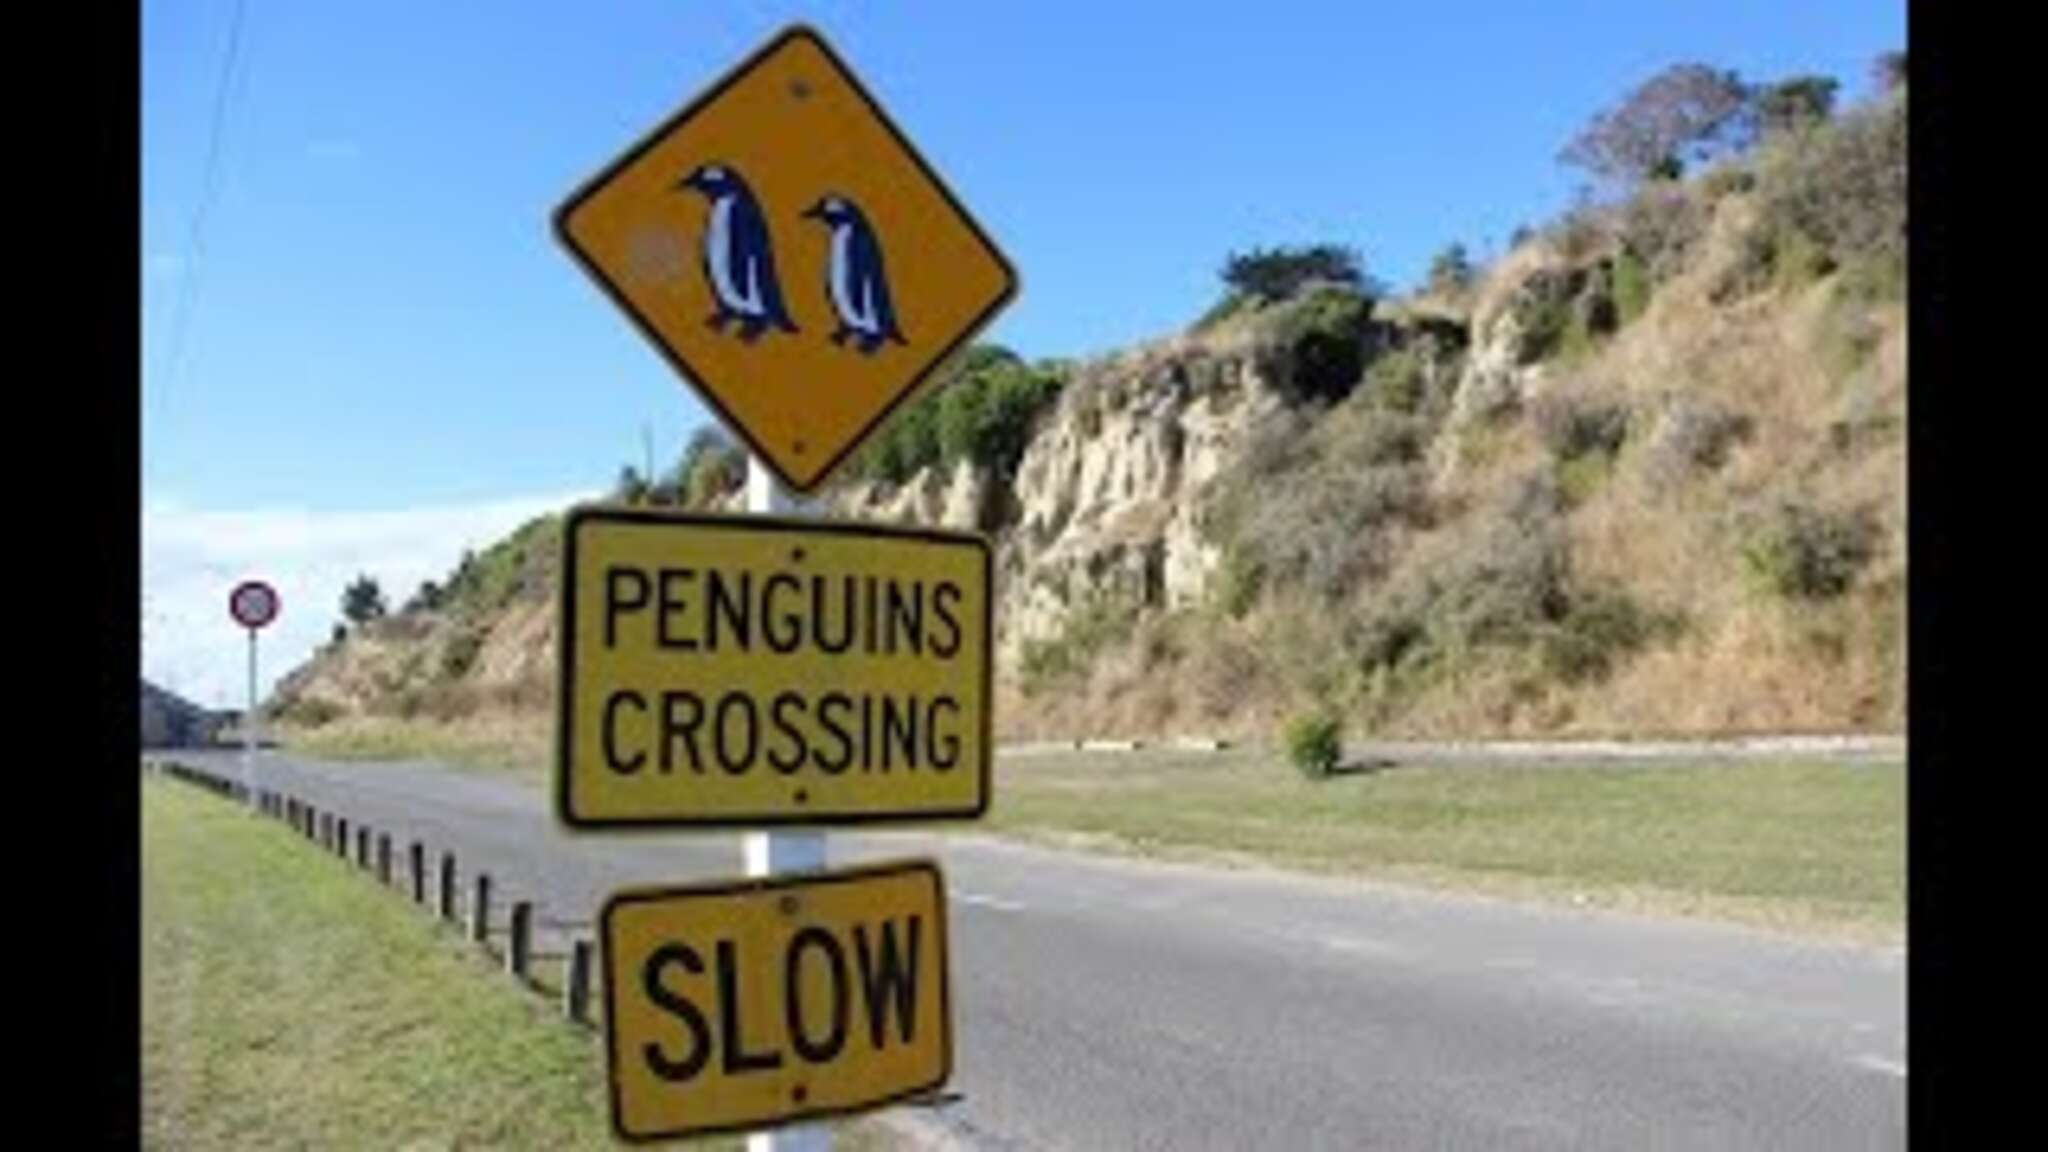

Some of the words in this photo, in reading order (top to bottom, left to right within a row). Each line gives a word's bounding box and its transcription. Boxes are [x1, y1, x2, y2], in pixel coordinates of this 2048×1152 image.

[604, 566, 962, 659] PENGUINS
[603, 690, 961, 775] CROSSING
[642, 914, 922, 1082] SLOW
